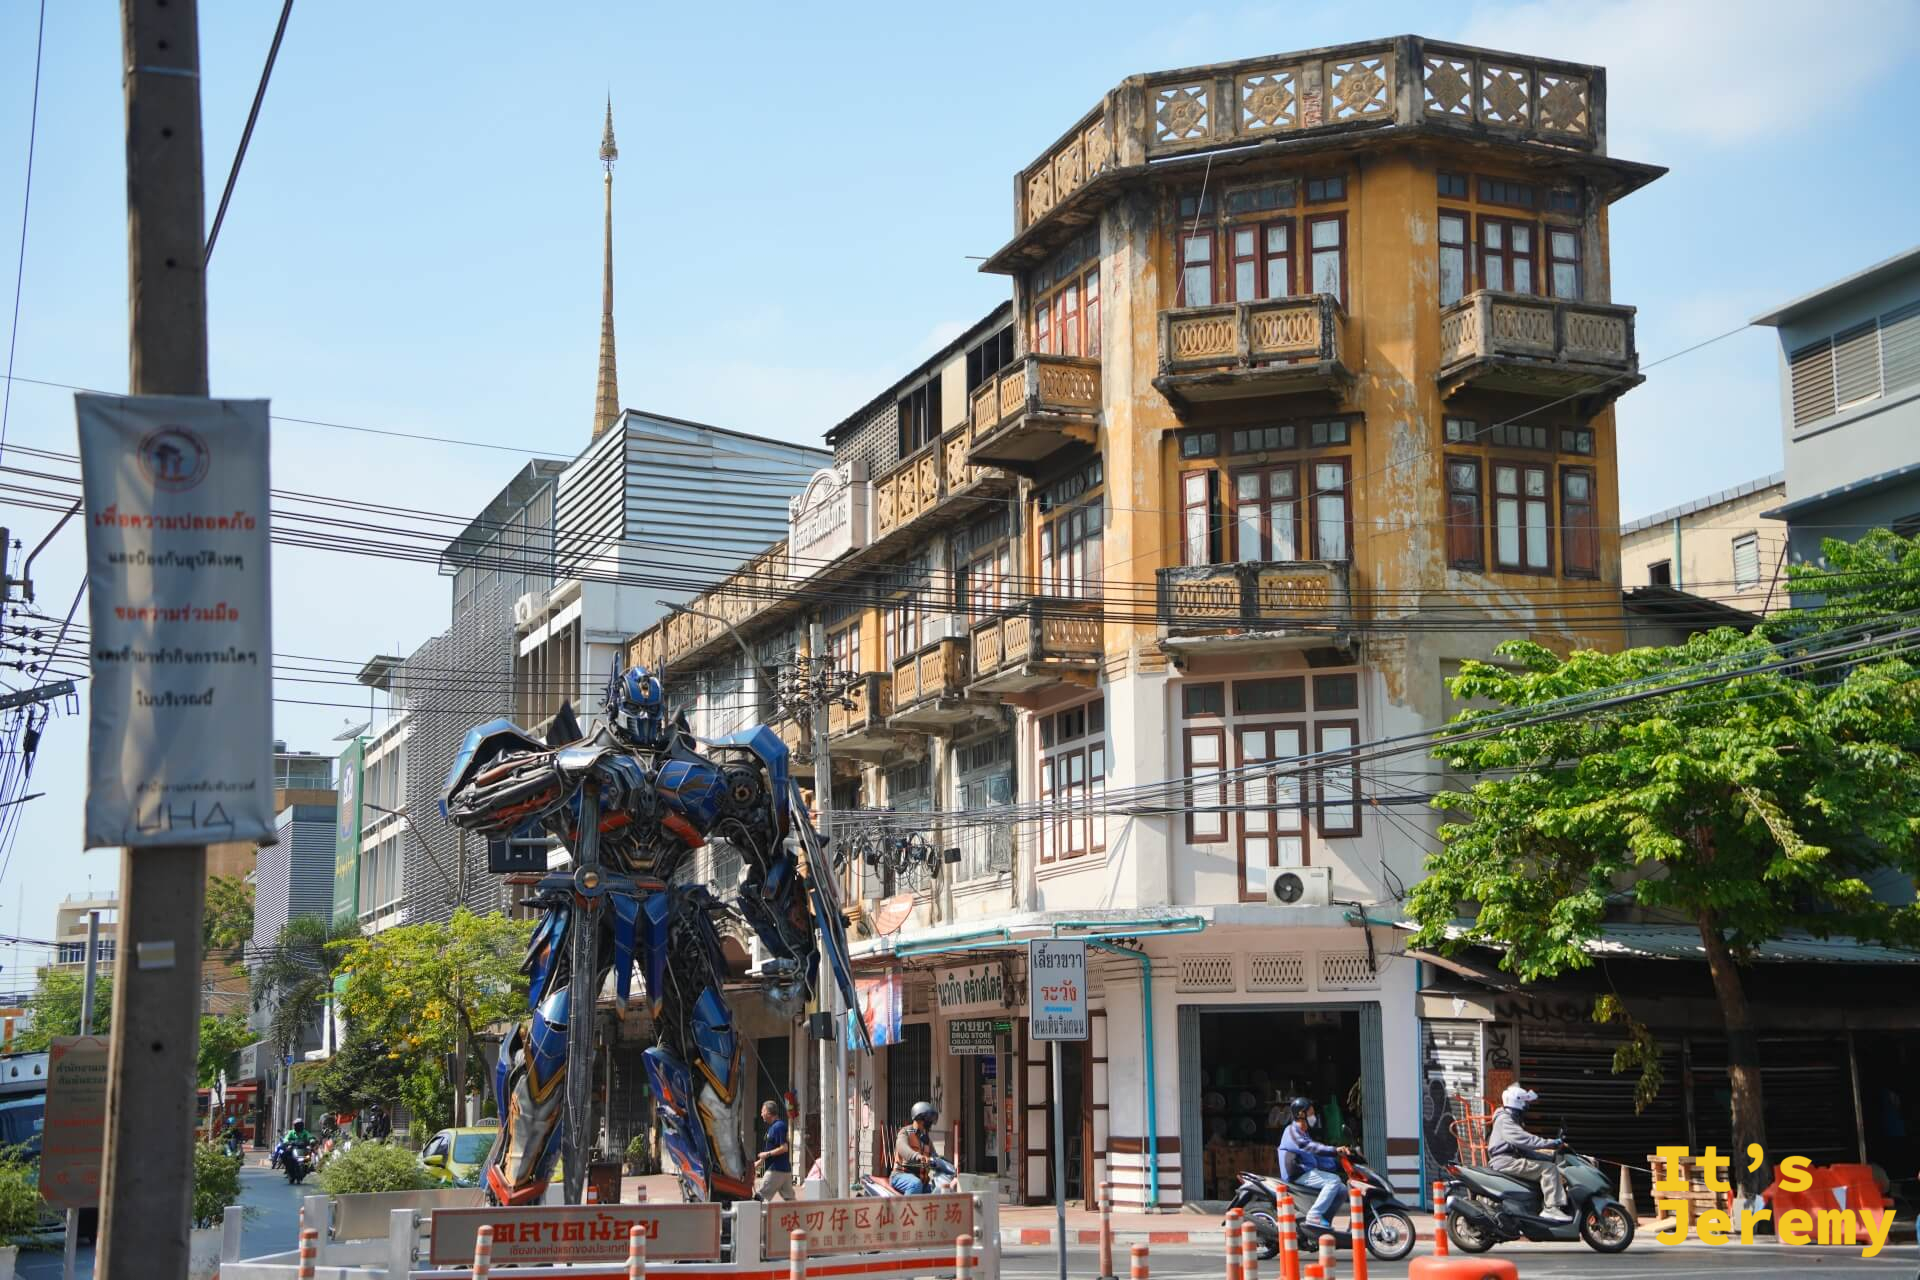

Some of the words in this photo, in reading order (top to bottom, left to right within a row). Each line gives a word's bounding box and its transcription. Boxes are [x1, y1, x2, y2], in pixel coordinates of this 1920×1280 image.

[94, 503, 256, 530] เพื่อความปลอดภัย
[114, 602, 239, 623] ขอความร่วมมือ
[1033, 943, 1082, 969] เลี้ยวขวา
[1040, 979, 1077, 1002] ระวัง
[492, 1213, 659, 1243] ตลาดน้อย
